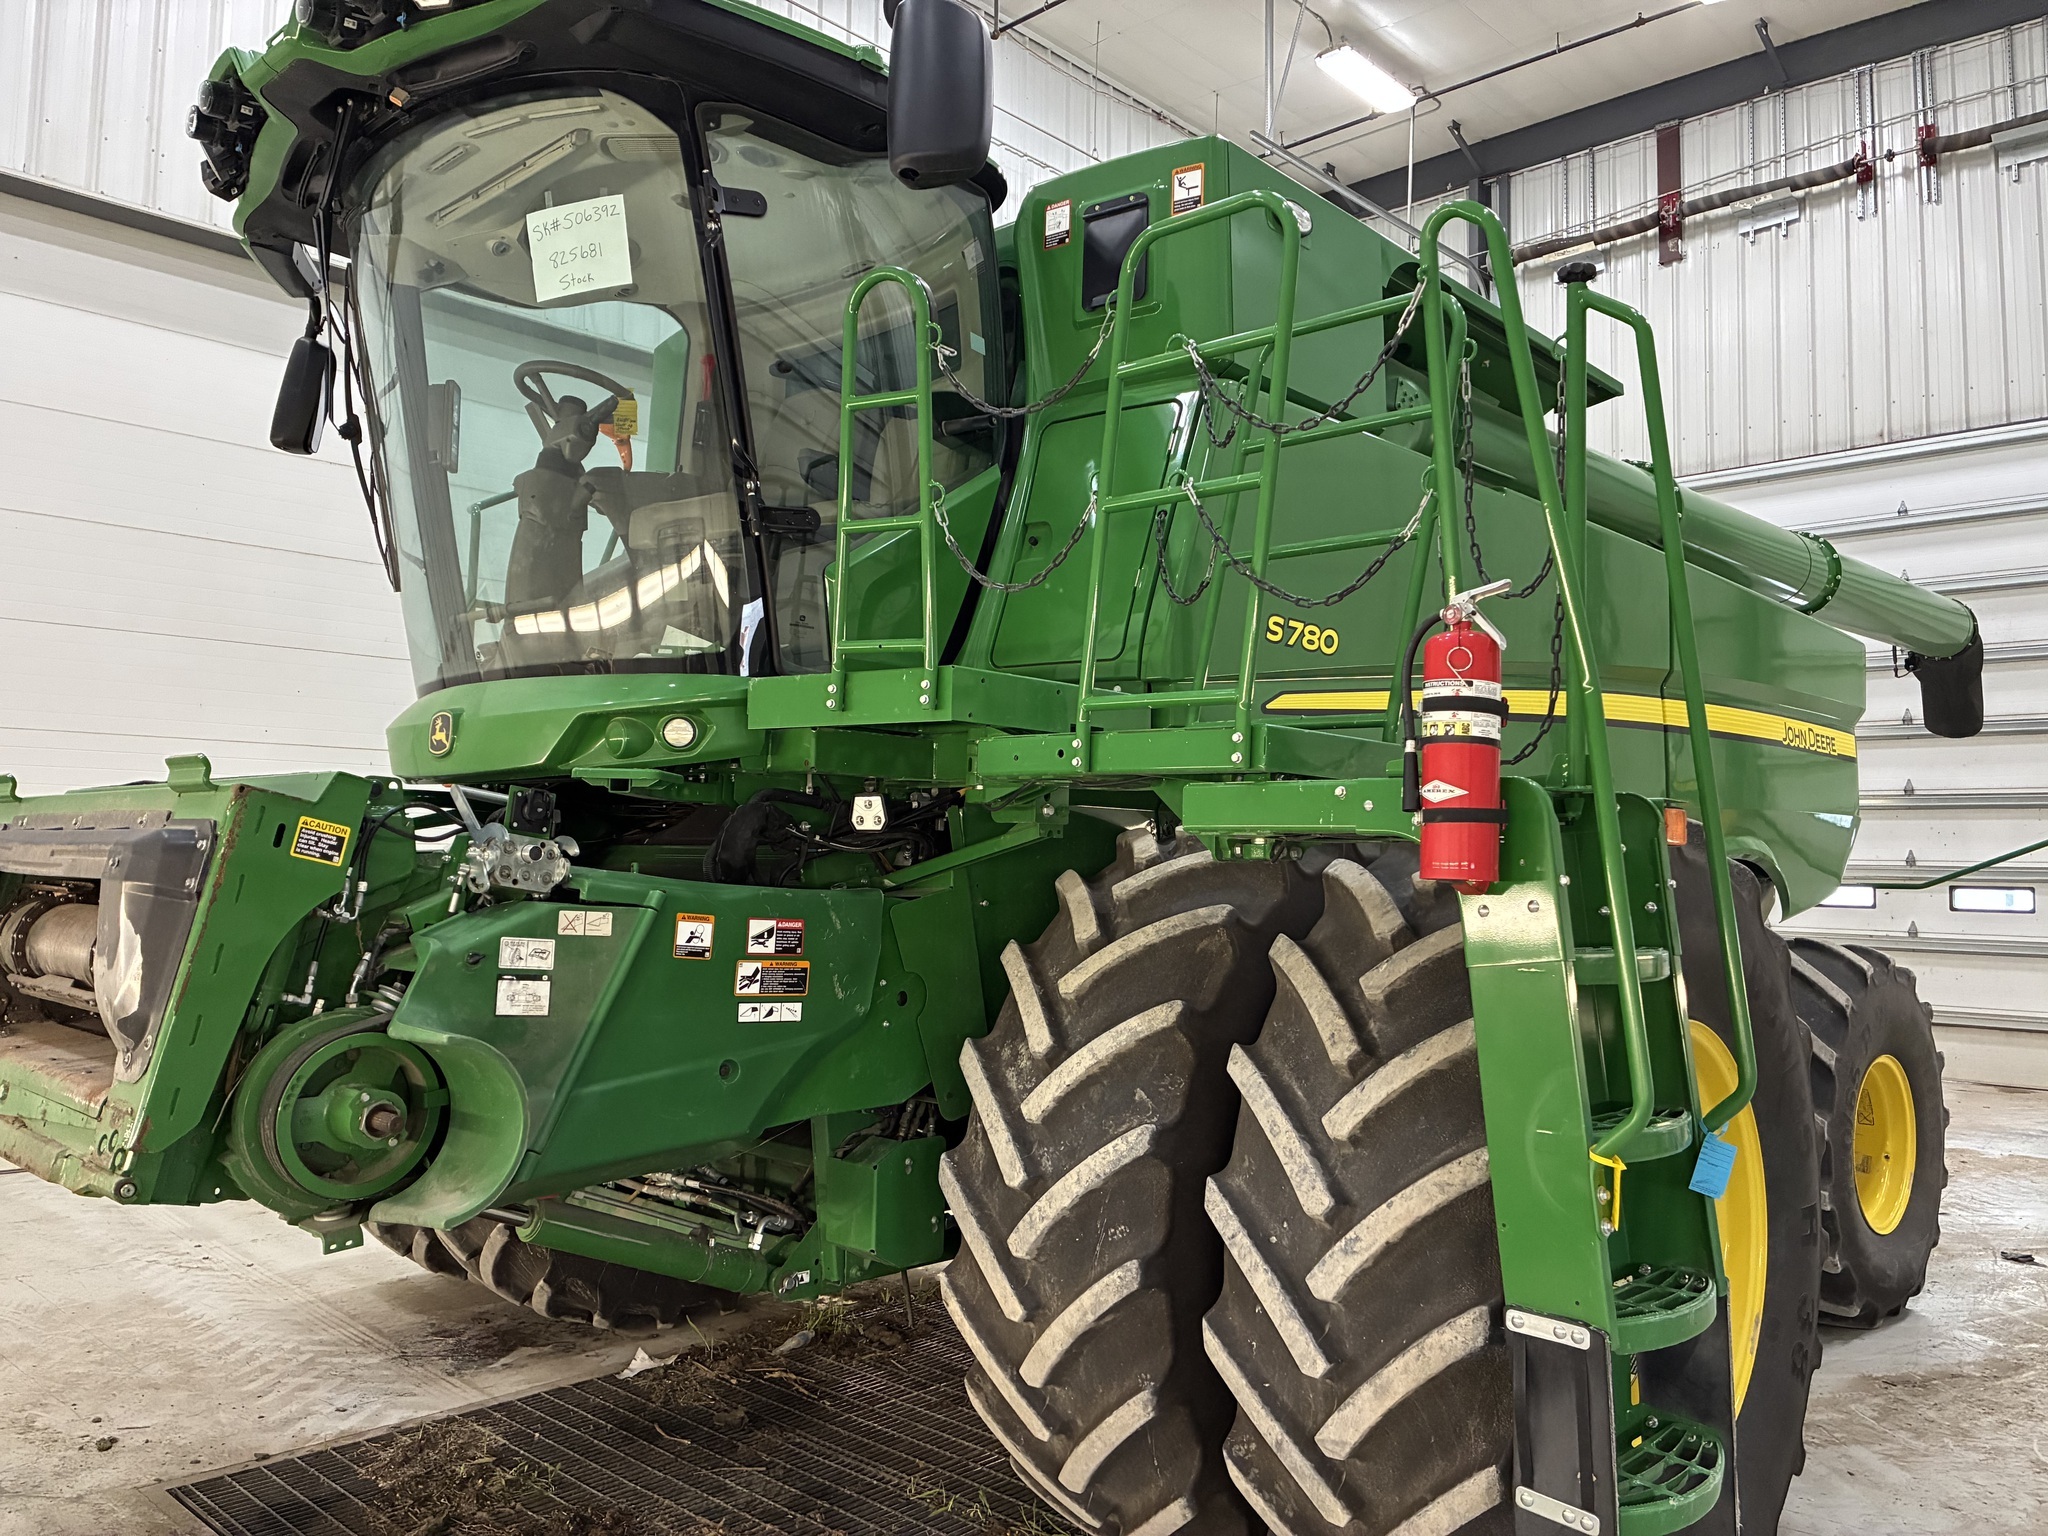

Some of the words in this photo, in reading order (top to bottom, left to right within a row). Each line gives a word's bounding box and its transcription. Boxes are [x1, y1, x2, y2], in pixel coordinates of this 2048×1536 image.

[1051, 199, 1070, 209] DANGER
[532, 204, 620, 242] SK#506392
[548, 242, 603, 269] 825681
[559, 272, 595, 291] Stock
[1265, 613, 1340, 656] S780
[1461, 722, 1470, 735] ABC
[1782, 721, 1807, 746] JOHN
[1808, 727, 1837, 753] DEERE
[308, 819, 348, 835] CAUTION
[315, 832, 337, 841] crushing
